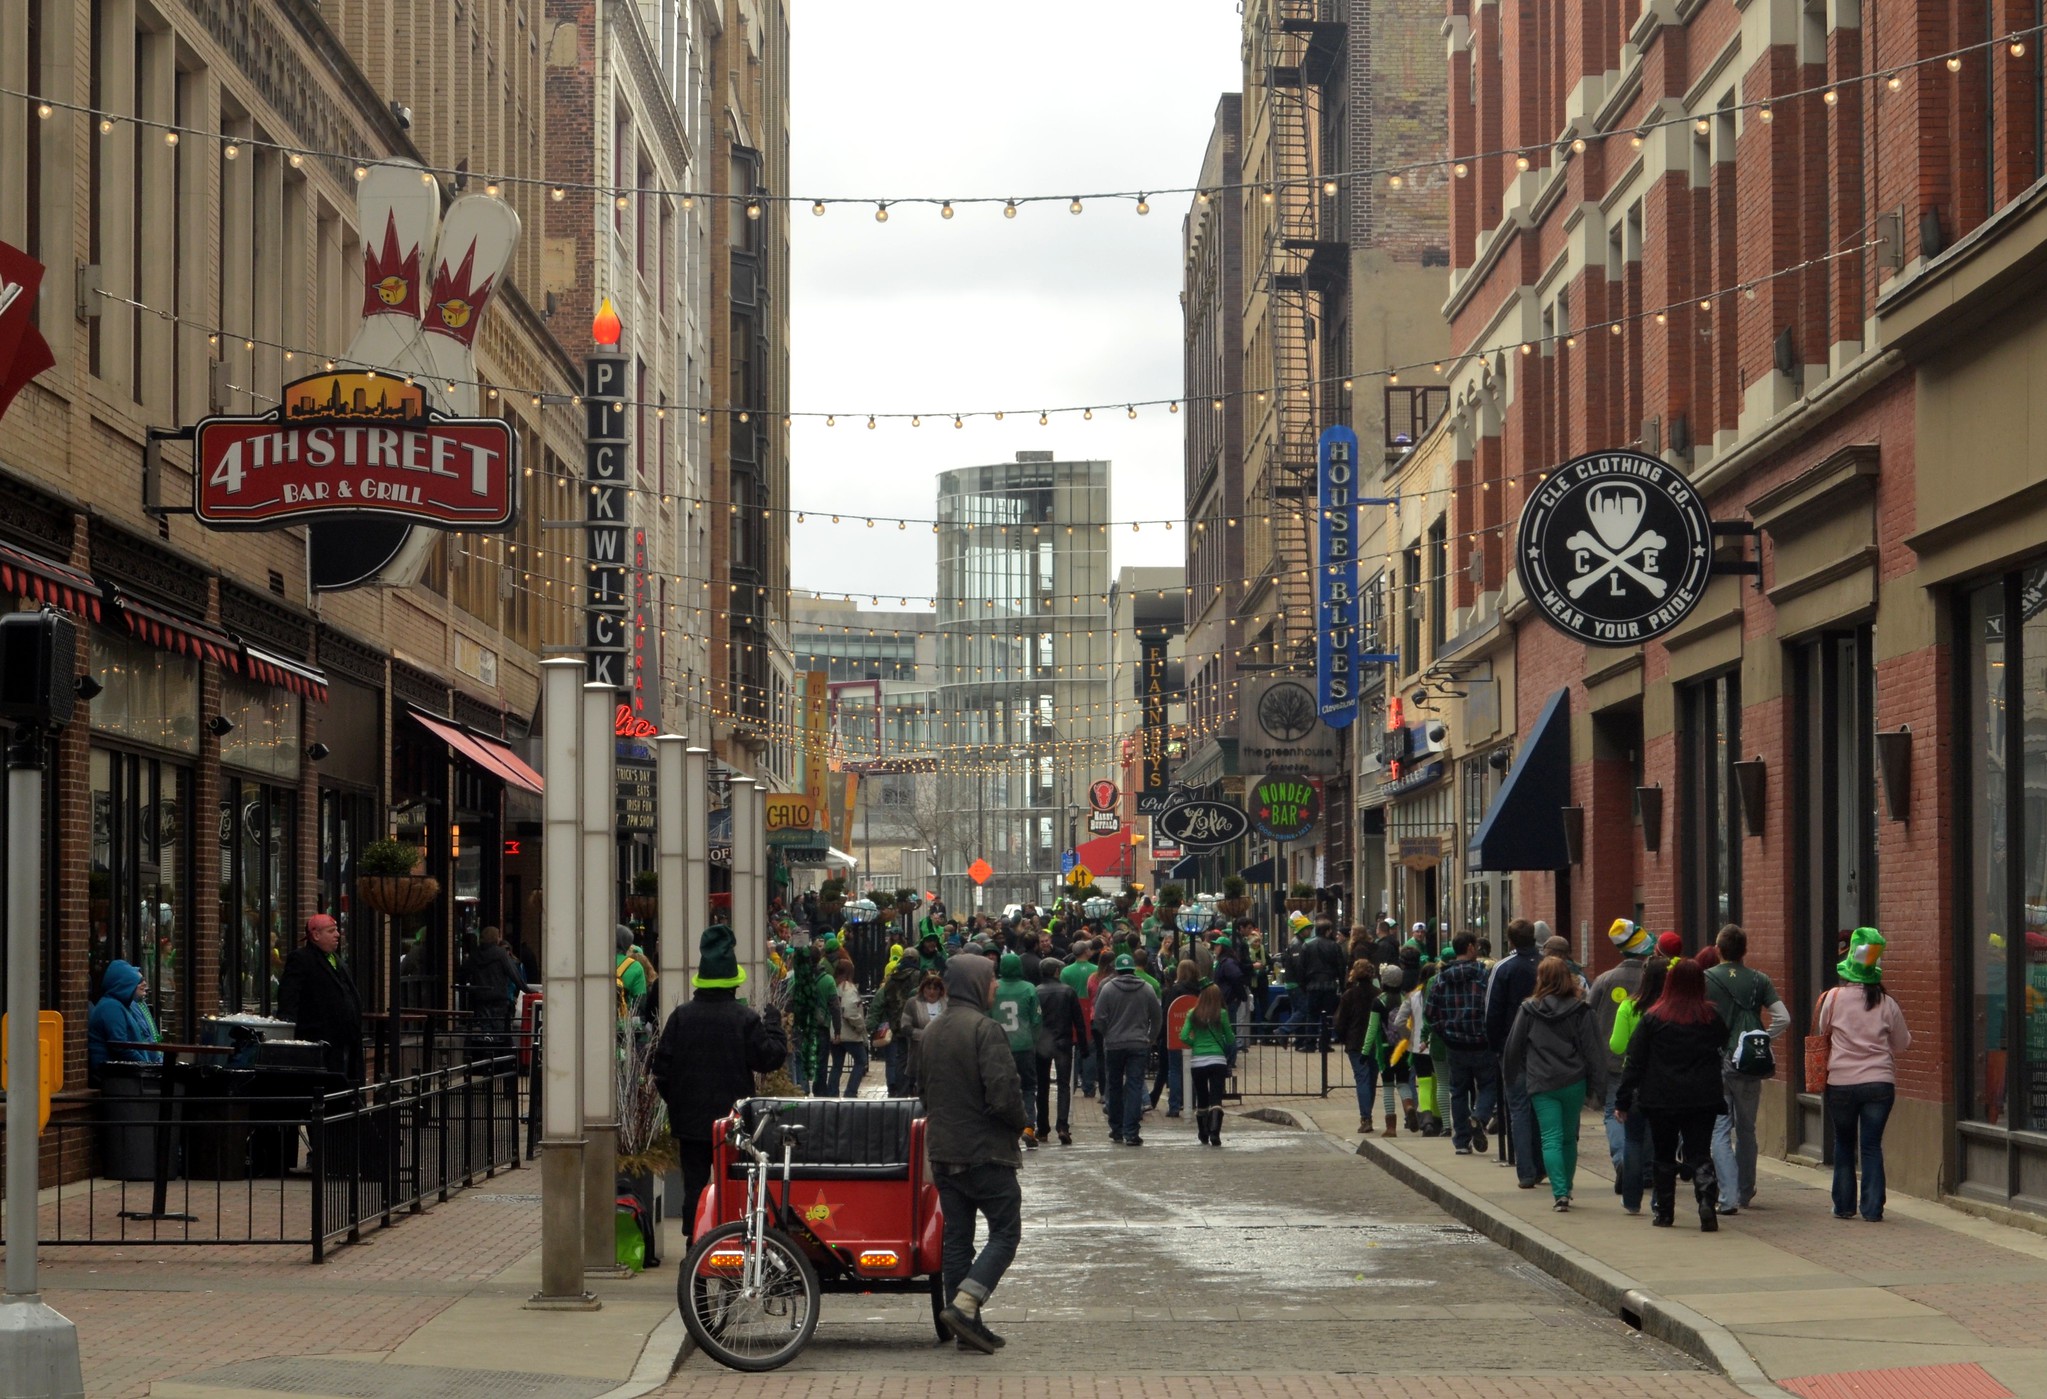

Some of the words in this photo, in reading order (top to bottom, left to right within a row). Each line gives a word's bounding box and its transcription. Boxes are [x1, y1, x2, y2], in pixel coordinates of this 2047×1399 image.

[209, 430, 299, 495] 4TH
[306, 426, 500, 497] STREET
[283, 482, 330, 503] BAR
[338, 480, 352, 498] &
[360, 478, 423, 505] GRILL
[1328, 441, 1351, 557] HOUSE
[1540, 475, 1571, 507] CLE
[1575, 457, 1663, 482] CLOTHING
[1667, 480, 1691, 509] CO.
[593, 363, 617, 685] PICKWICK
[635, 531, 645, 711] RESTAURAN
[1543, 590, 1584, 630] WEAR
[1595, 621, 1640, 638] YOUR
[1648, 587, 1694, 630] PRIDE
[1328, 581, 1349, 698] BLUES
[617, 768, 637, 781] TRICK'S
[640, 769, 651, 782] DAY
[636, 785, 650, 797] EATS
[1258, 782, 1313, 805] WONDER
[640, 815, 654, 828] SHOW
[1271, 804, 1297, 826] BAR
[1000, 1000, 1019, 1032] 3
